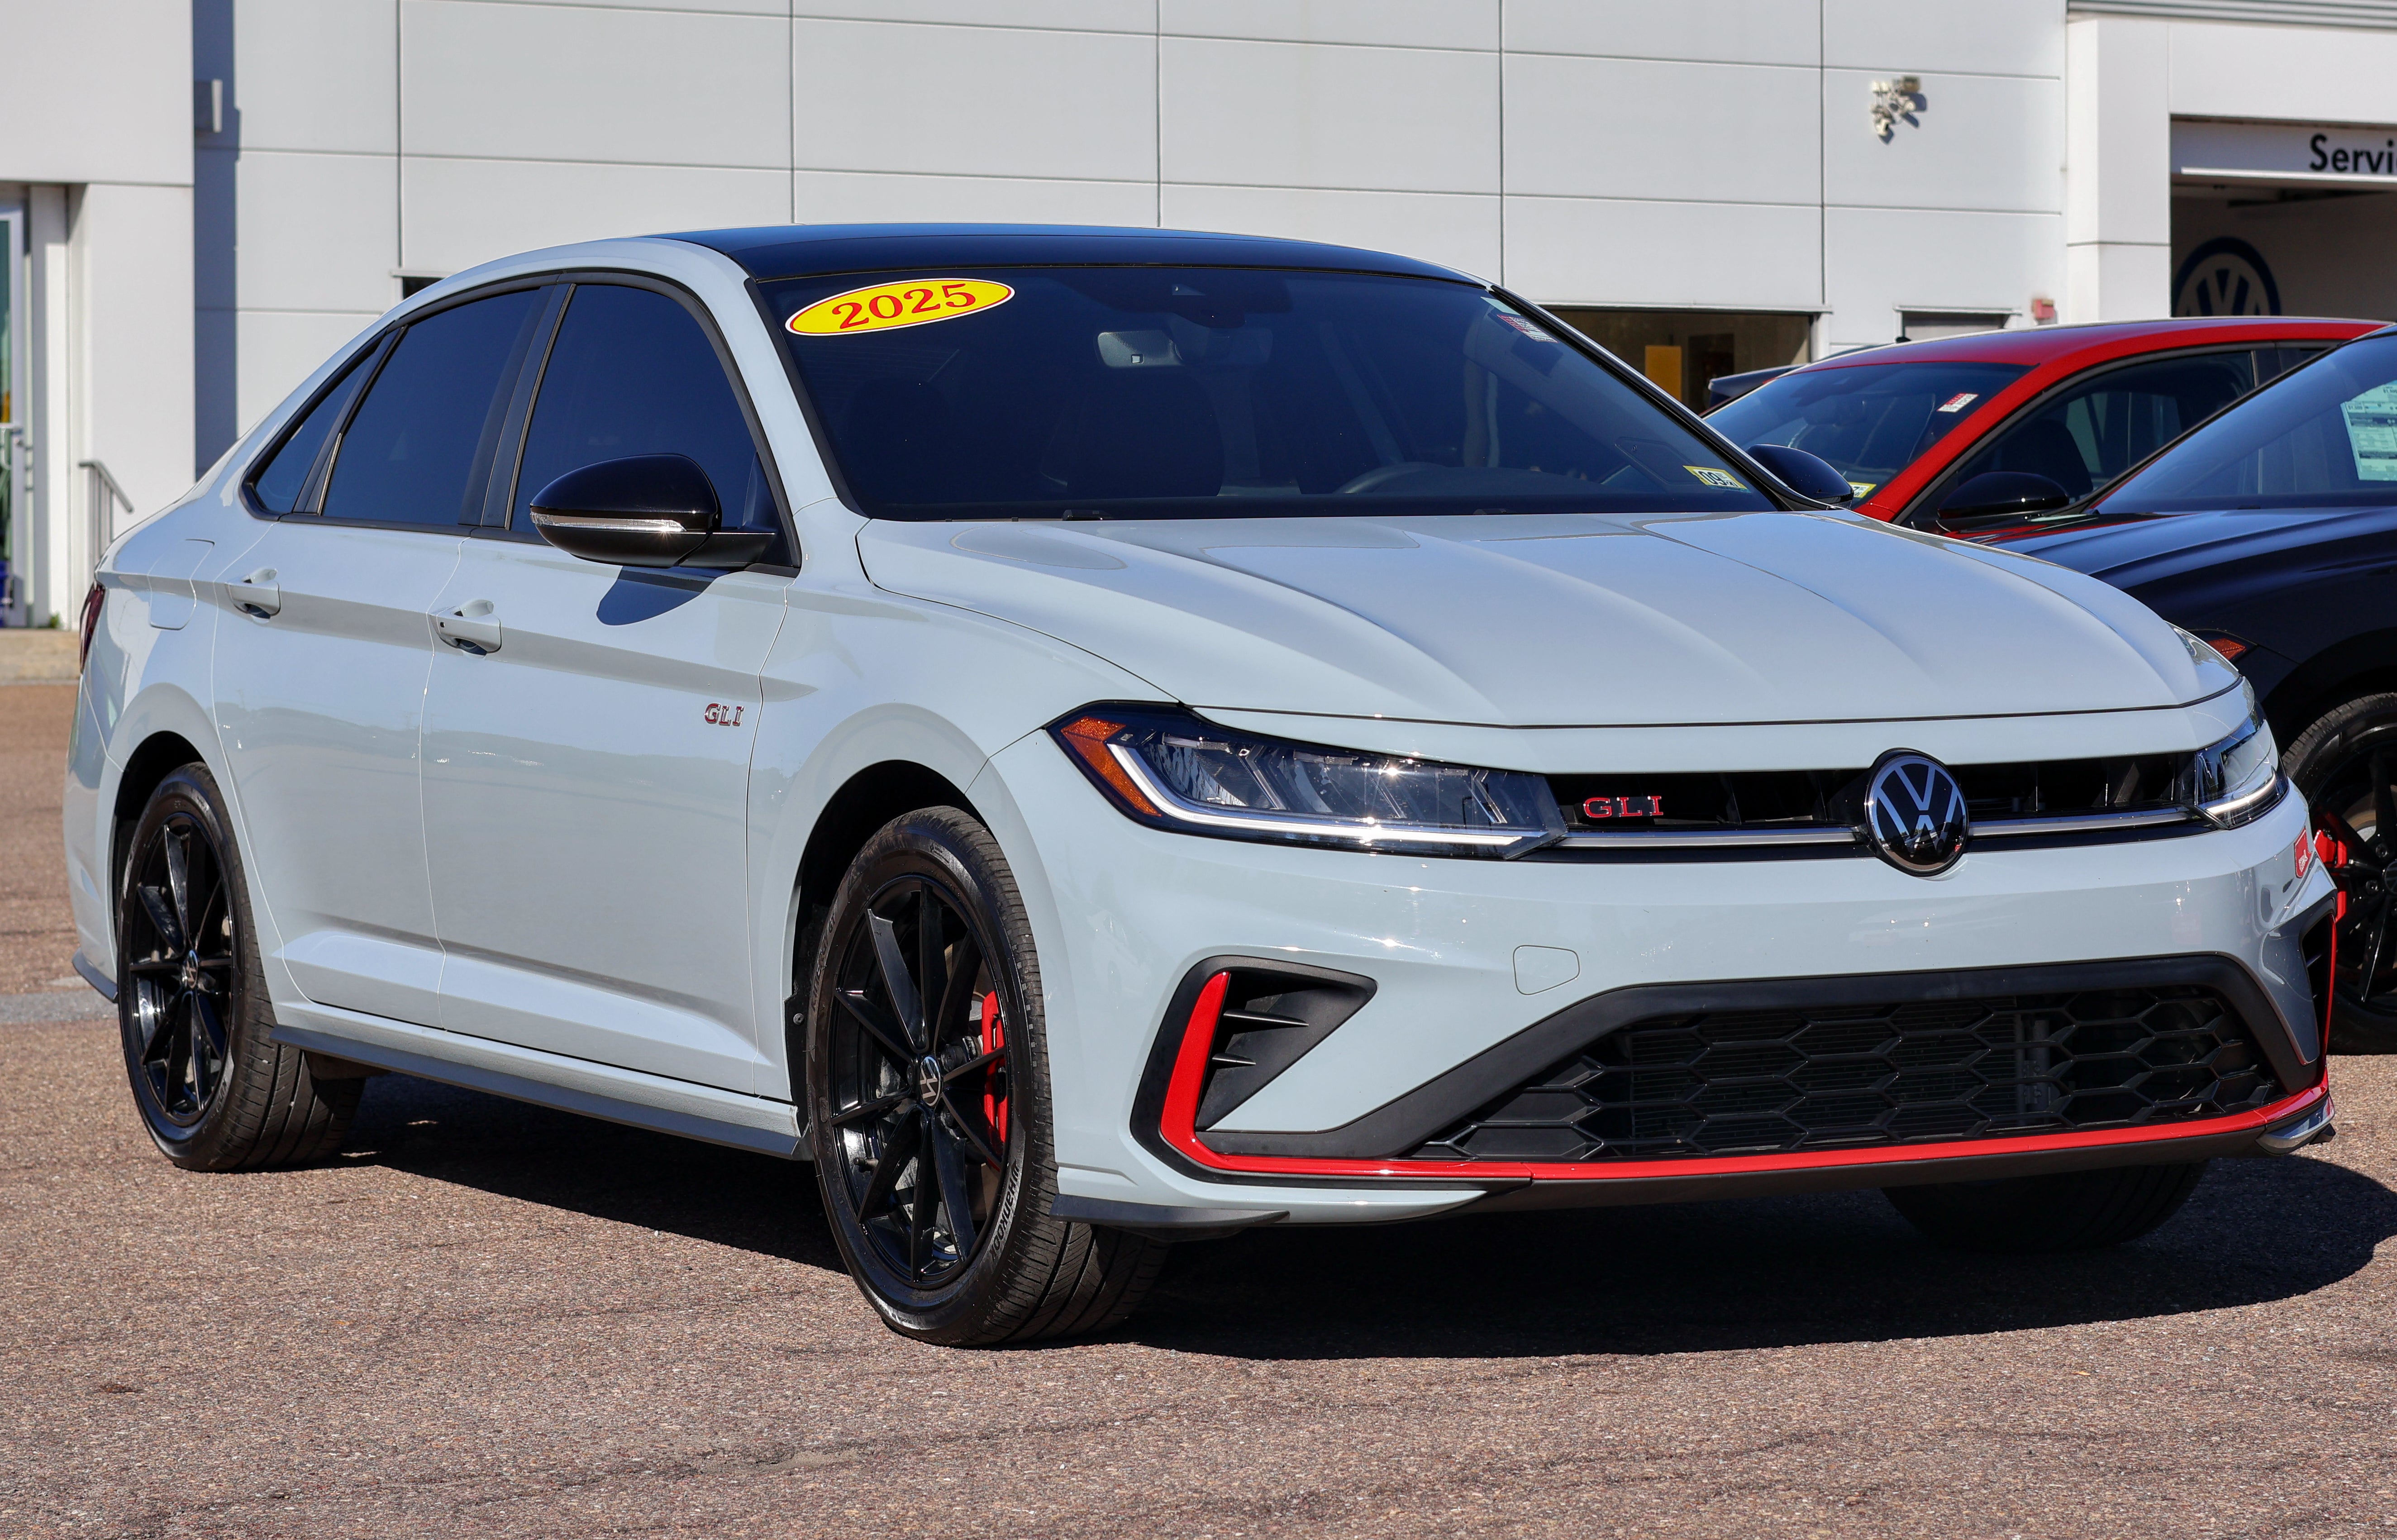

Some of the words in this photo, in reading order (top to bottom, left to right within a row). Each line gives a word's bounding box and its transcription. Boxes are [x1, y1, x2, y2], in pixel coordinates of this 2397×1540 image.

[2310, 133, 2397, 173] Servi
[832, 283, 976, 329] 2025
[1697, 471, 1728, 486] 09
[704, 703, 745, 727] GLI
[1583, 796, 1664, 818] GLI
[1868, 755, 1967, 872] VW
